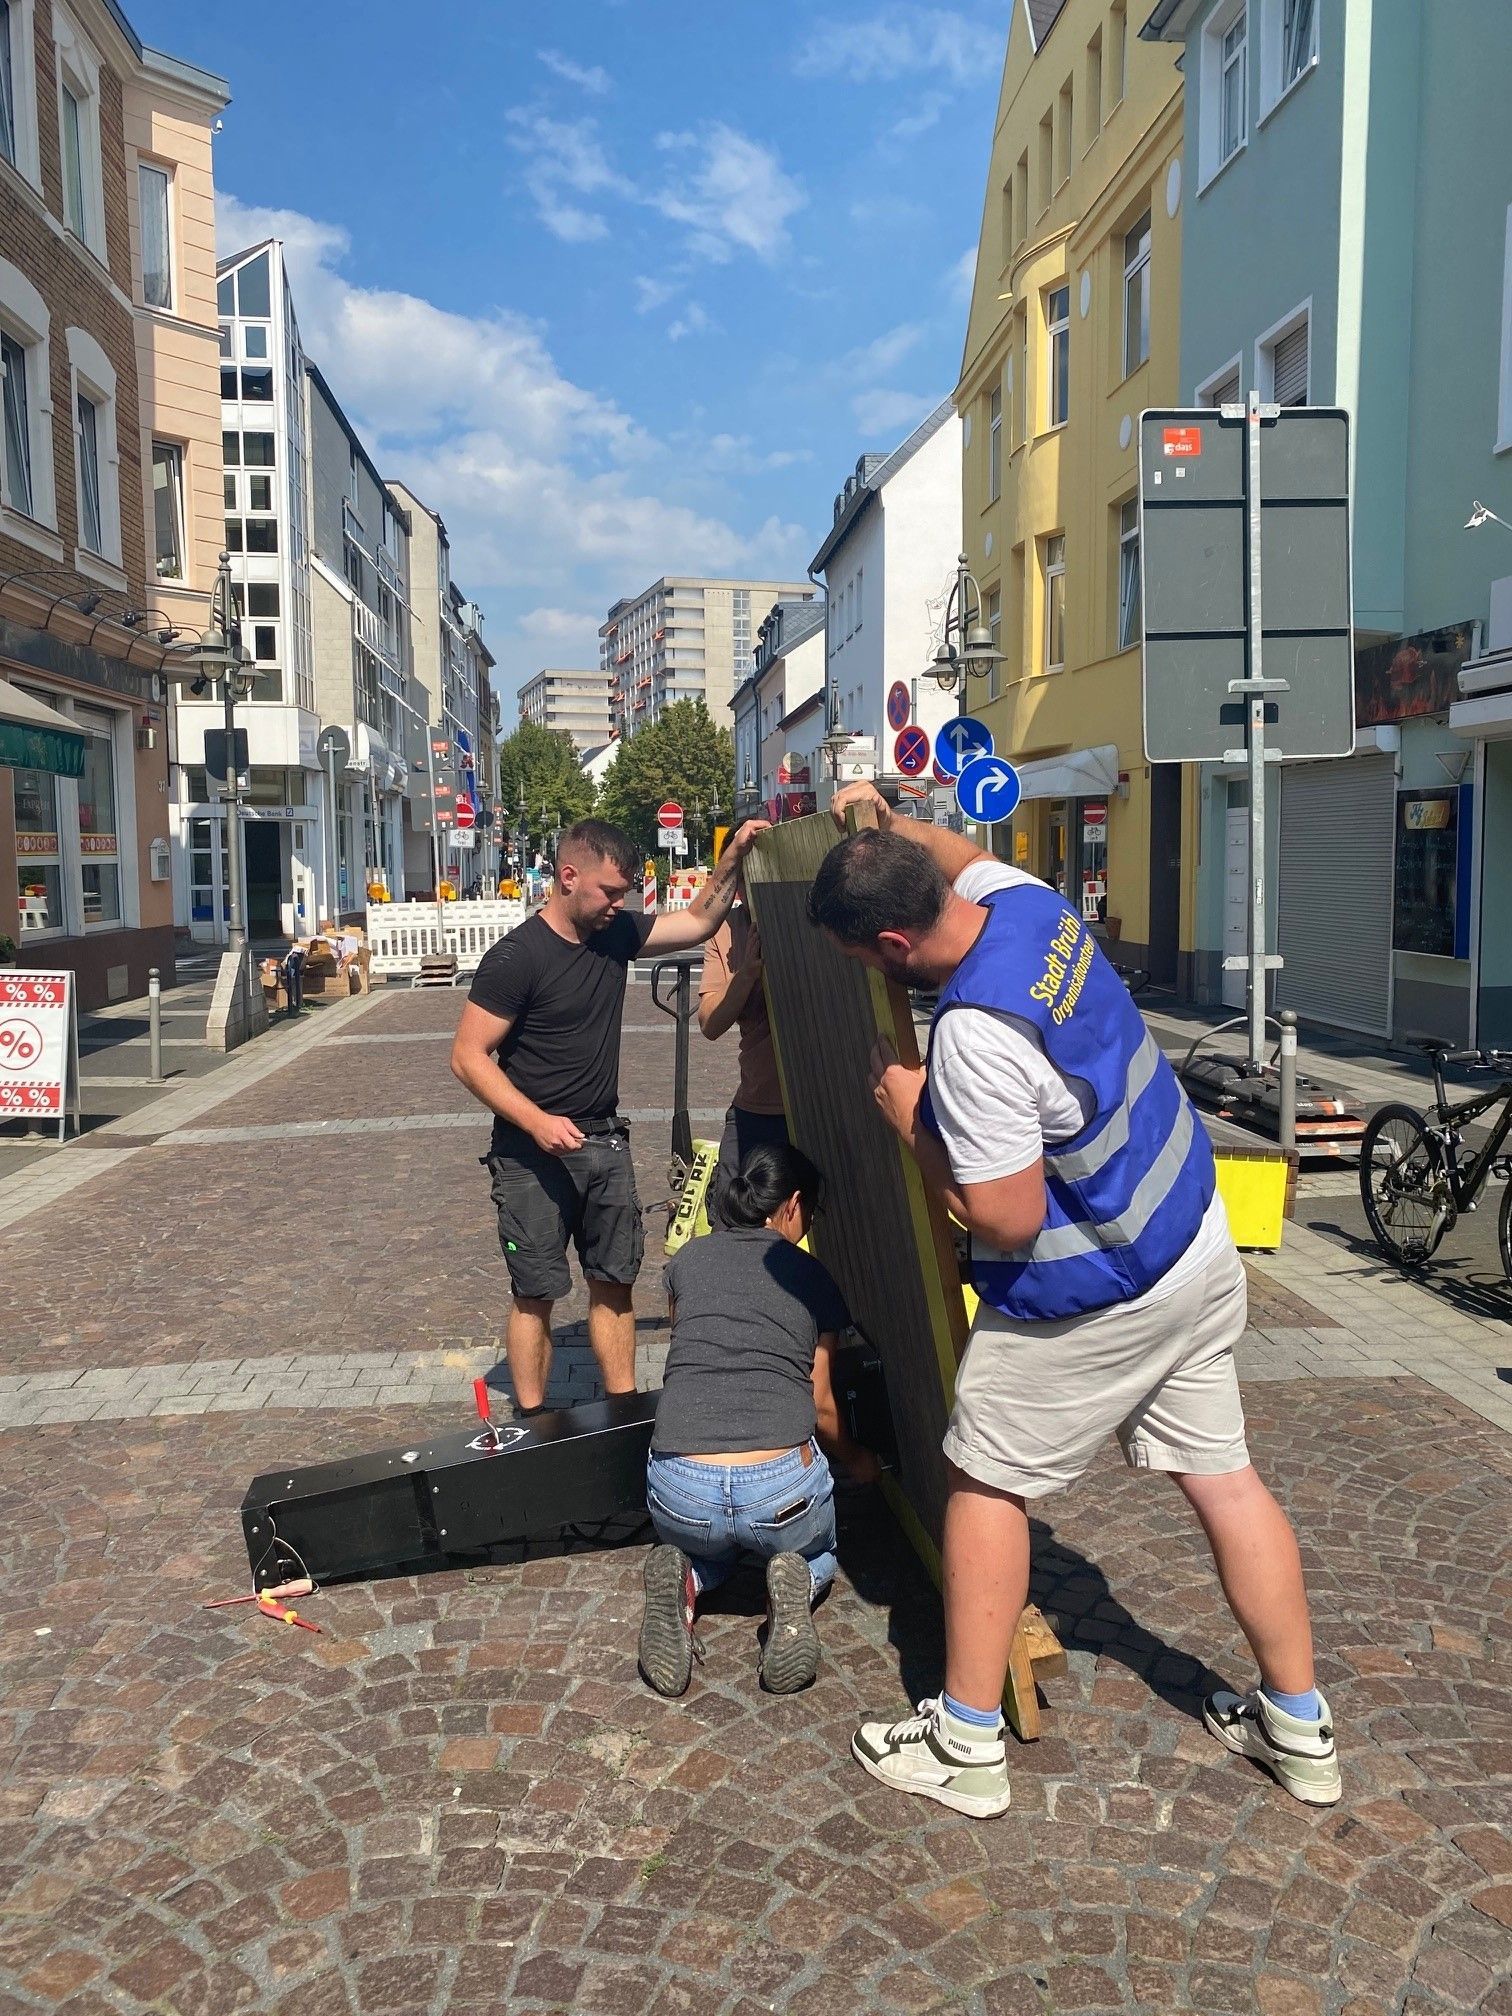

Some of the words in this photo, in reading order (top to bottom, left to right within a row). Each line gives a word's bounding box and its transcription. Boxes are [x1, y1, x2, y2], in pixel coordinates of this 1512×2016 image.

[1029, 953, 1068, 1008] Stadt
[1050, 908, 1081, 961] Brühl
[948, 1738, 972, 1755] PUMA
